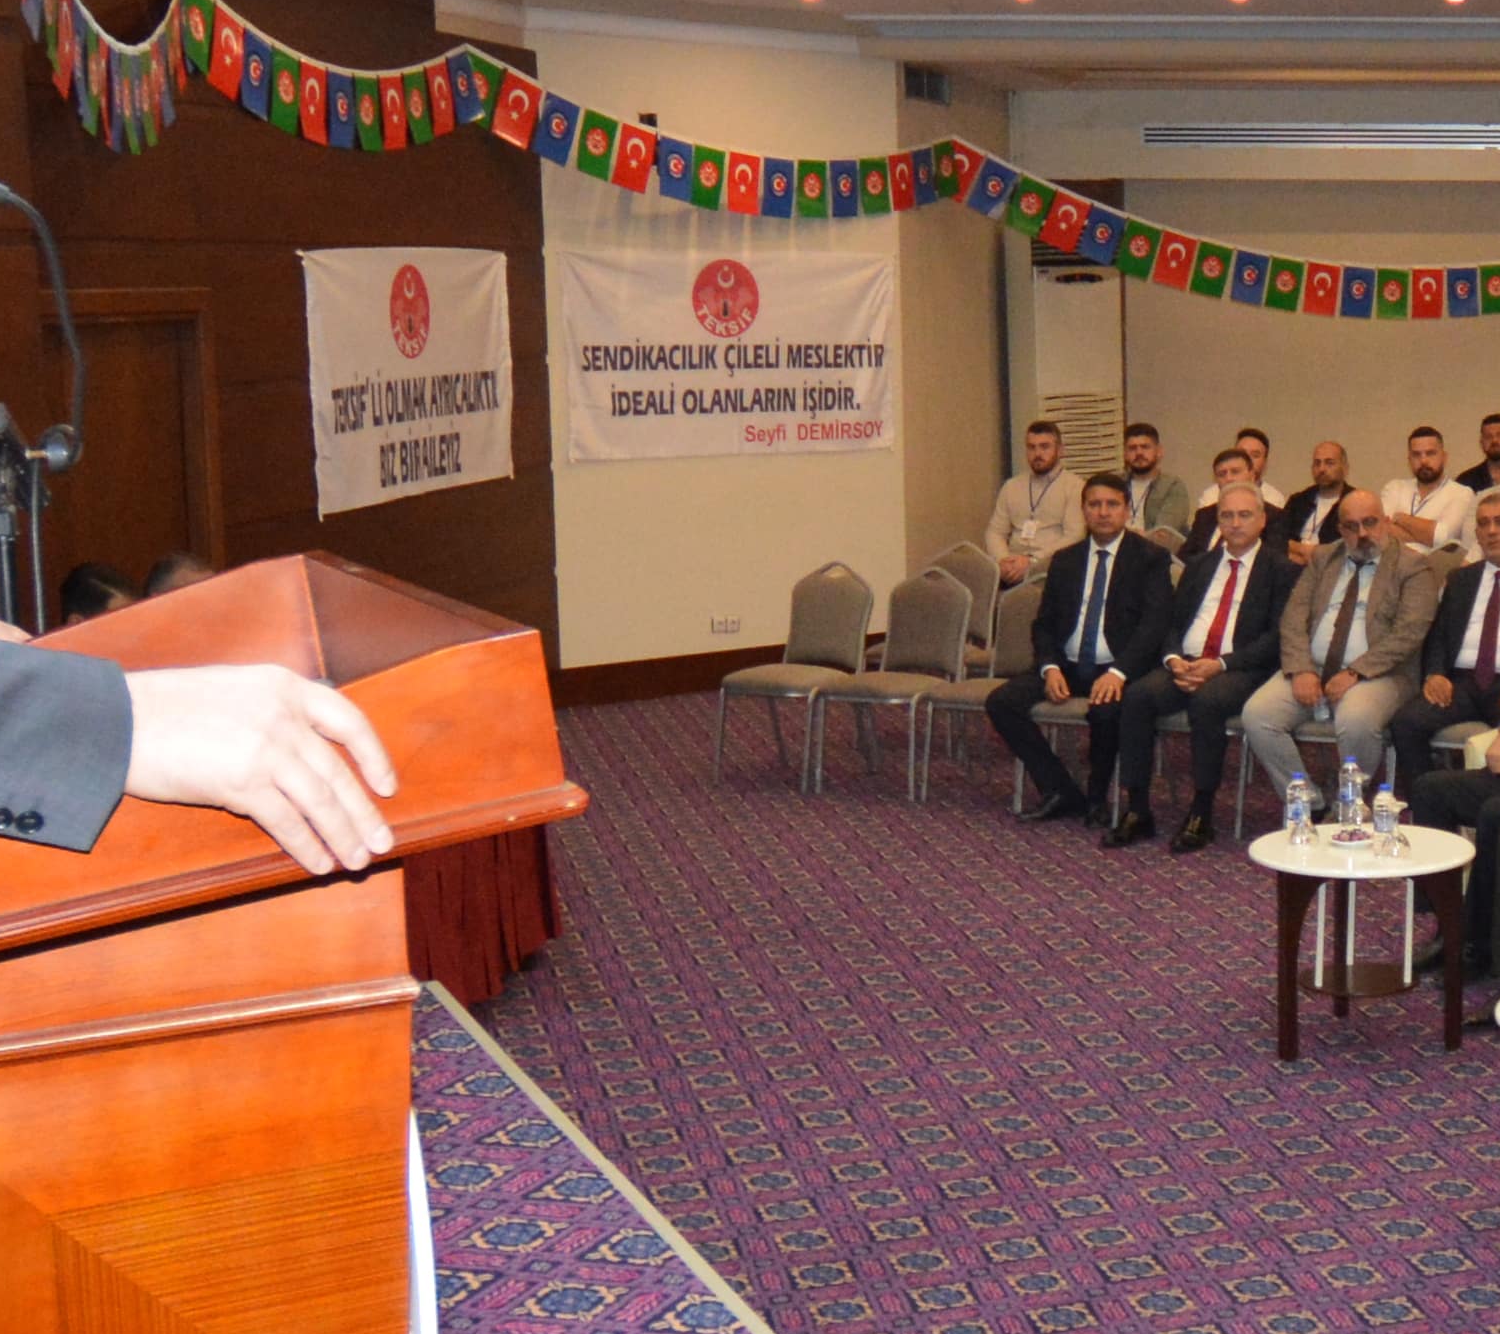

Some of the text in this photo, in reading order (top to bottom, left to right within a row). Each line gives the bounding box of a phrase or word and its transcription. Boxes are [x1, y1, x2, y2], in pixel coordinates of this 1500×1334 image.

[582, 337, 884, 377] SENDİKACILIK ÇİLELİ MESLEKTİR
[385, 377, 427, 424] OLMAK
[611, 380, 860, 419] İDEALİ OLANLARIN İŞİDİR.
[744, 419, 884, 446] Seyfi DEMİRSOY
